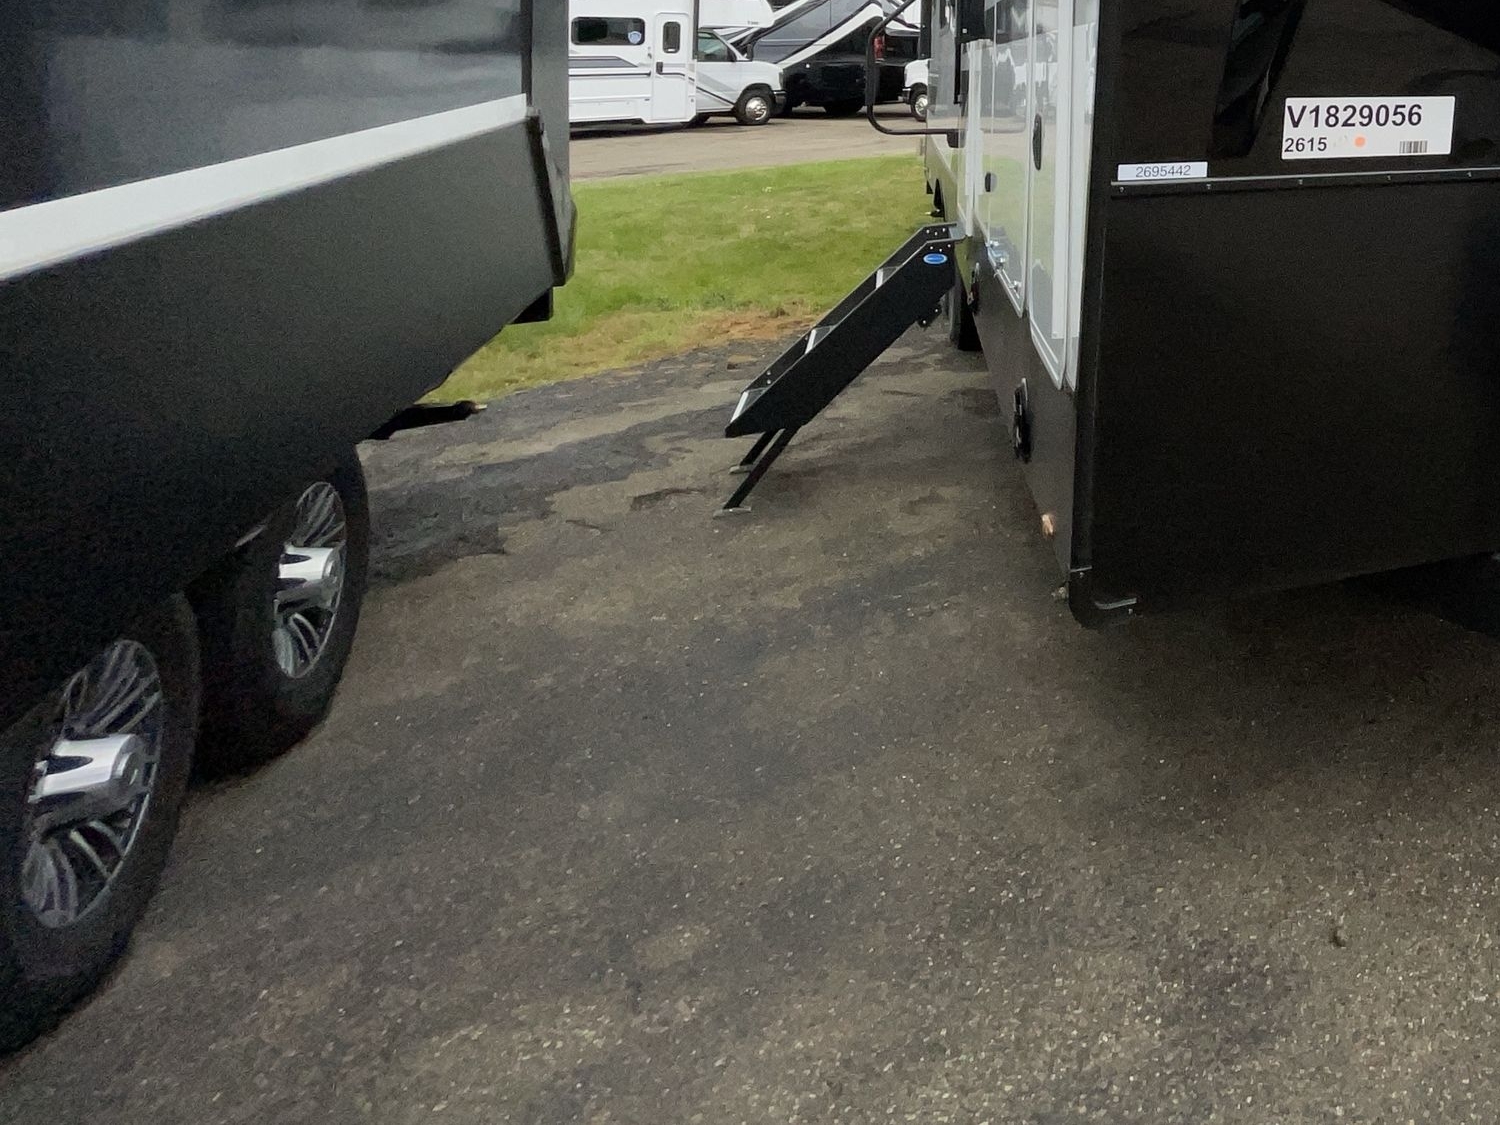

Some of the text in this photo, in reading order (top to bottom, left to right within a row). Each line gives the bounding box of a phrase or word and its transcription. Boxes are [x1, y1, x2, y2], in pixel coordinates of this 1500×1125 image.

[1287, 103, 1423, 129] V1829056
[1284, 137, 1327, 153] 2615
[1135, 164, 1191, 178] 2695442
